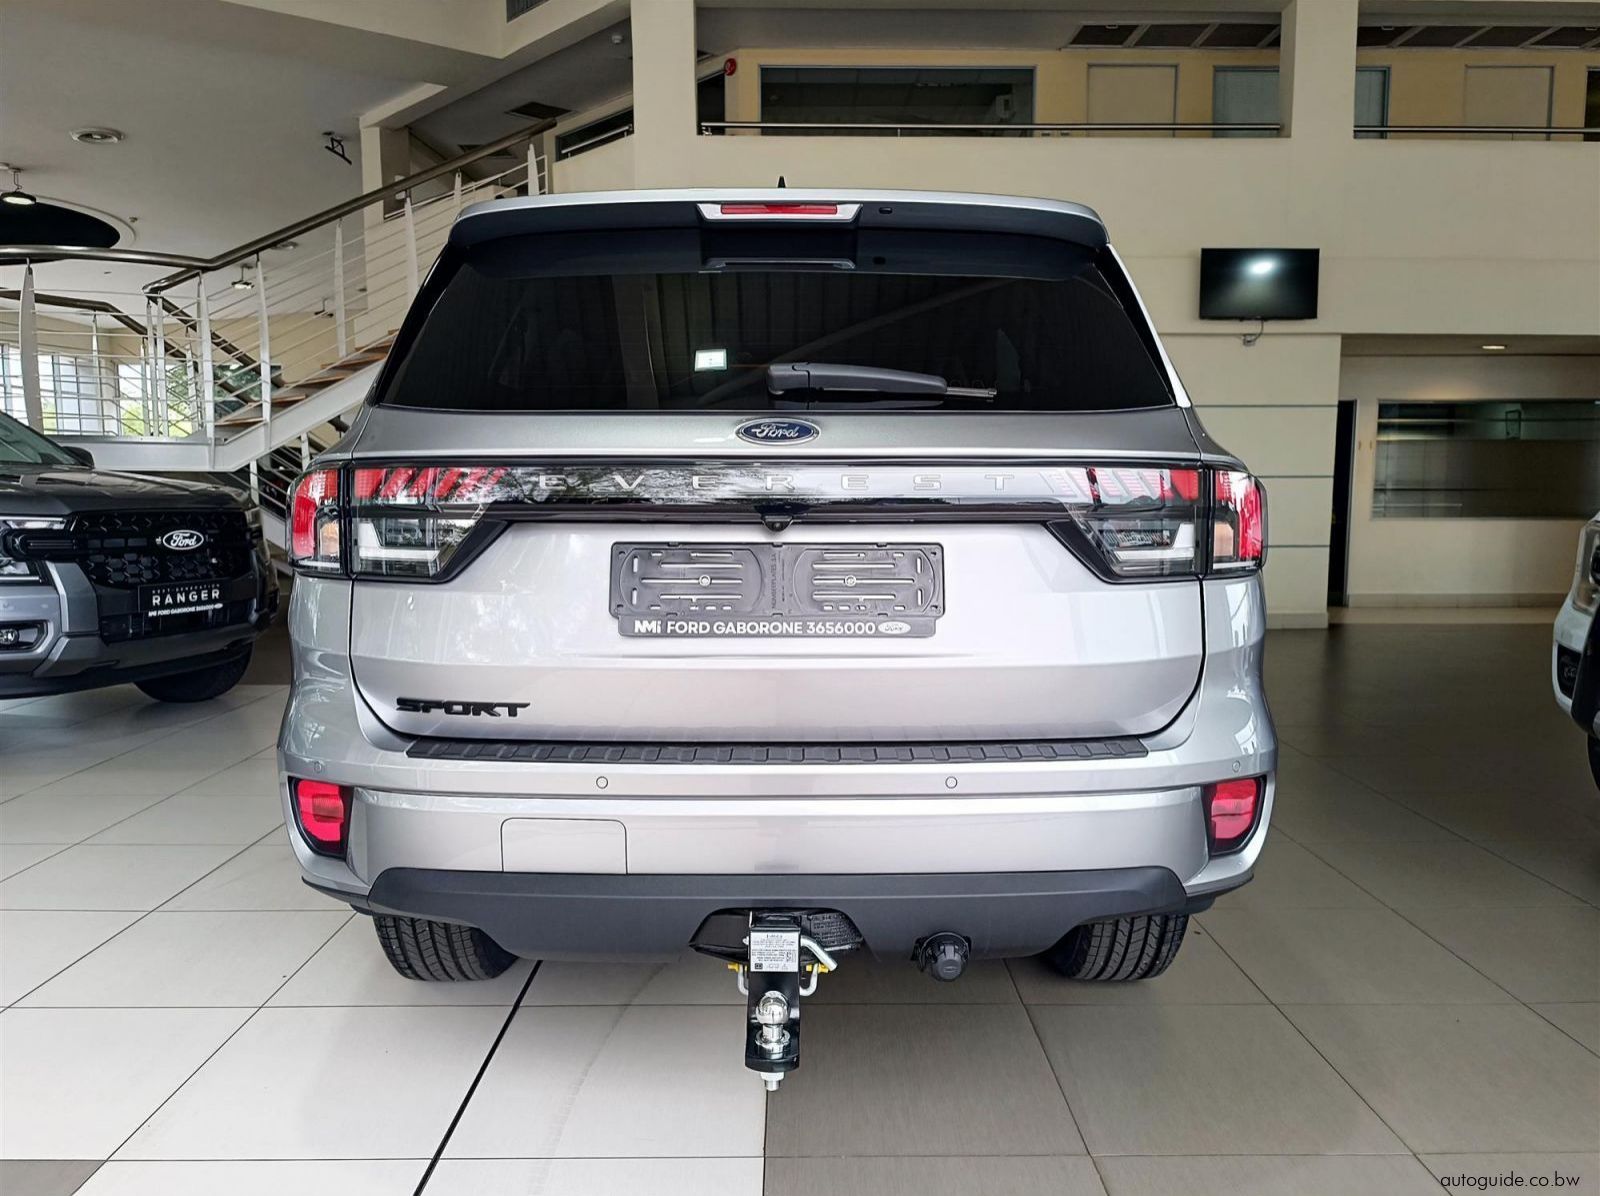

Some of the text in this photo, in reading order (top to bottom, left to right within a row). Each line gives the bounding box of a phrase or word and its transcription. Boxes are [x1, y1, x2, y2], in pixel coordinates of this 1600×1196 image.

[752, 423, 800, 437] Ford
[538, 473, 1016, 491] EVEREST
[170, 532, 197, 547] Ford
[152, 588, 220, 606] RANGER
[666, 621, 711, 634] FORD
[713, 621, 803, 634] GABORONE
[806, 621, 876, 634] 3656000
[395, 697, 531, 717] SPORT
